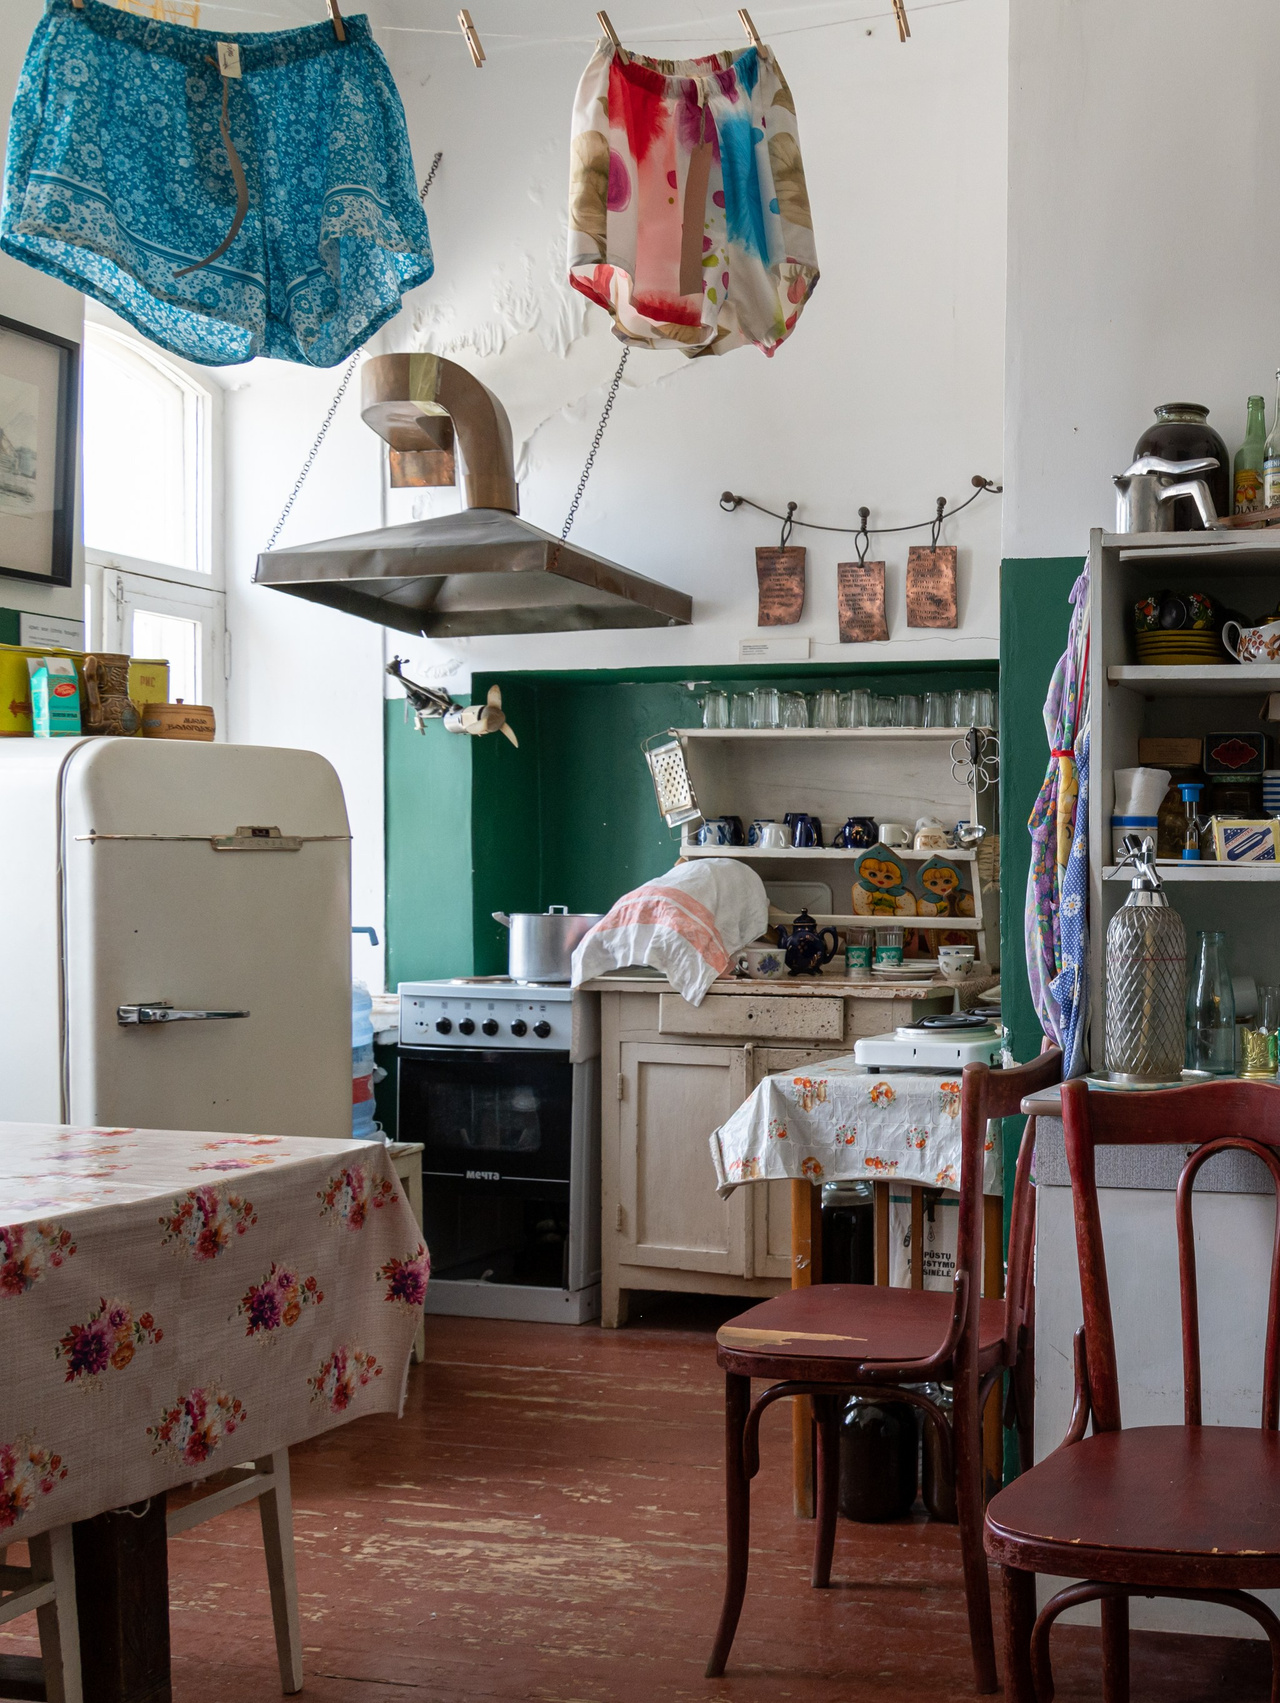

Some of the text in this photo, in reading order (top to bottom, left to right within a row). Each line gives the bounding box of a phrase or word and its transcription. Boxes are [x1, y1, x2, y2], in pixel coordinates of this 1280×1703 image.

[140, 675, 156, 688] РИС
[924, 1250, 951, 1261] PŪSTŲ
[923, 1267, 951, 1277] ŠINĖLĖ
